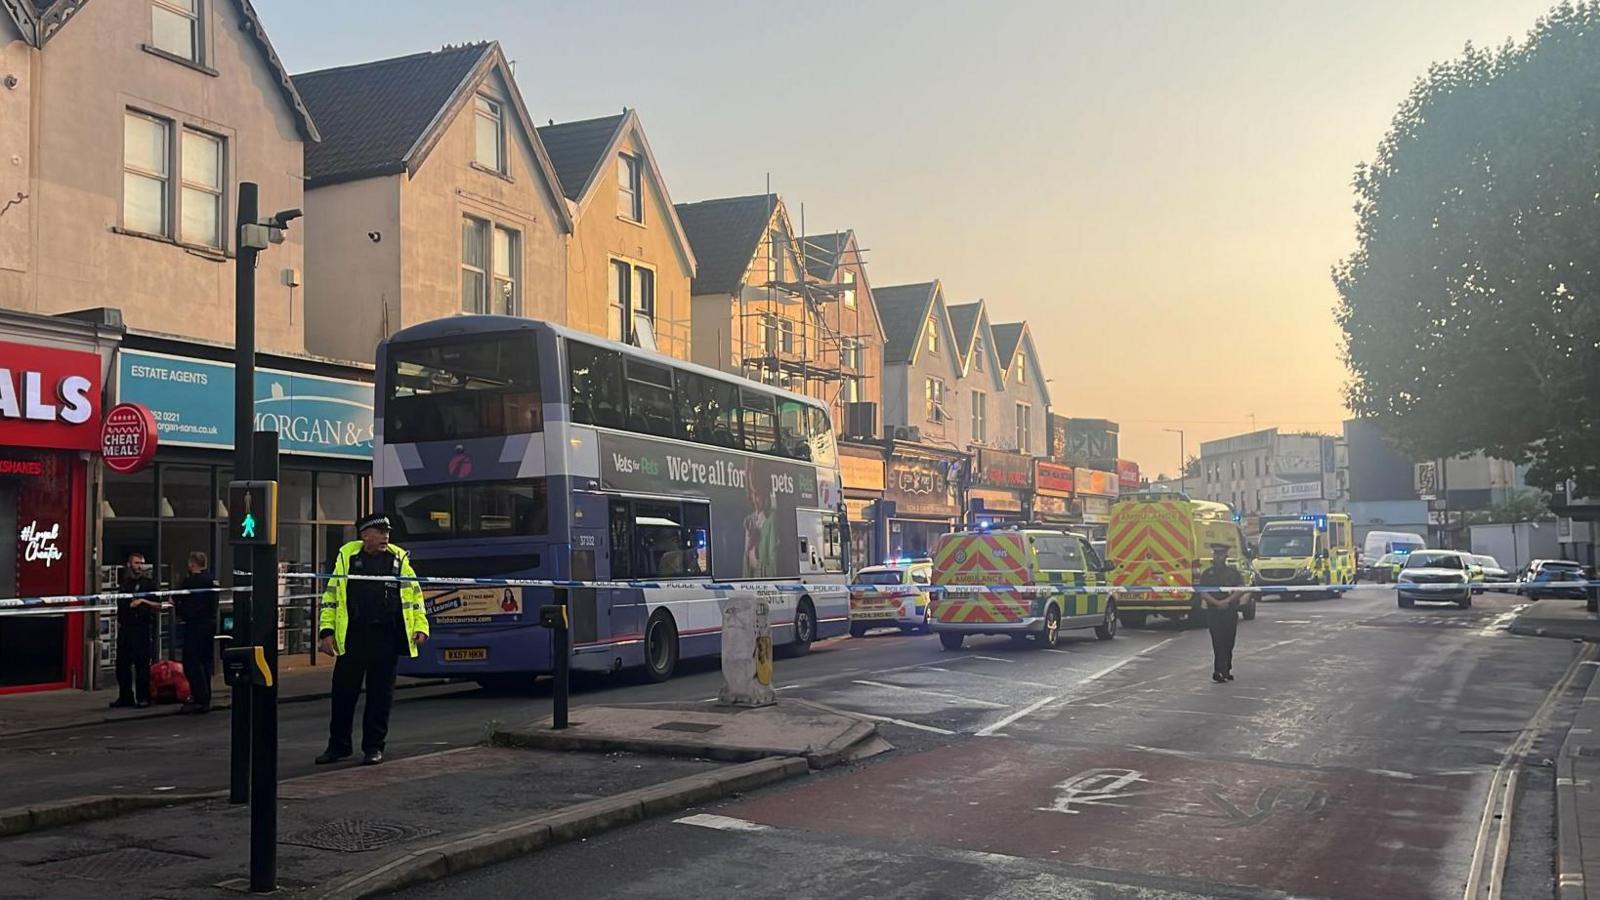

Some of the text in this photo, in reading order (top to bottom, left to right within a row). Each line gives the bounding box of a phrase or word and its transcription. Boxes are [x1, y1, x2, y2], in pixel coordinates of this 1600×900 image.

[131, 364, 208, 386] ESTATE AGENTS
[162, 411, 180, 422] 0221
[104, 433, 140, 446] CHEAT
[345, 422, 363, 447] &
[103, 444, 140, 457] MEALS
[613, 452, 659, 476] Vets for Pets
[666, 455, 794, 499] We're all for pets
[1119, 511, 1180, 521] AMBULANCE
[955, 575, 1002, 583] AMBULANCE
[432, 599, 459, 614] Learning
[852, 611, 892, 619] POLICE
